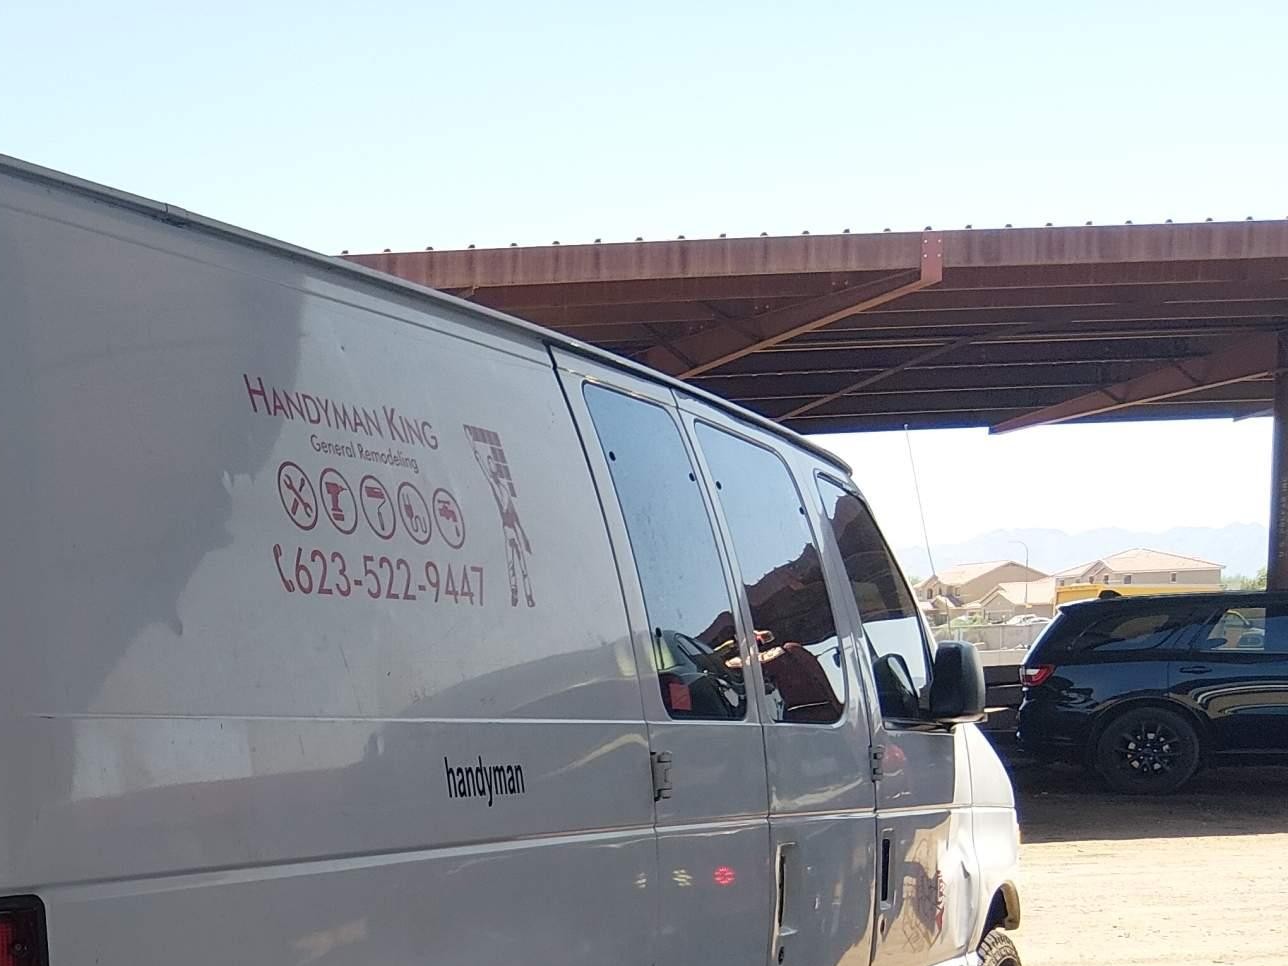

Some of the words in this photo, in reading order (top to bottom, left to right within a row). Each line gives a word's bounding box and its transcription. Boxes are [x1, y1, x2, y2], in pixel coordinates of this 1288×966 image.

[243, 373, 384, 438] HANDYMAN
[382, 405, 439, 450] KING
[310, 434, 357, 458] General
[357, 442, 420, 474] Remodeling
[295, 546, 485, 606] 623-522-9447
[443, 754, 526, 808] handyman
